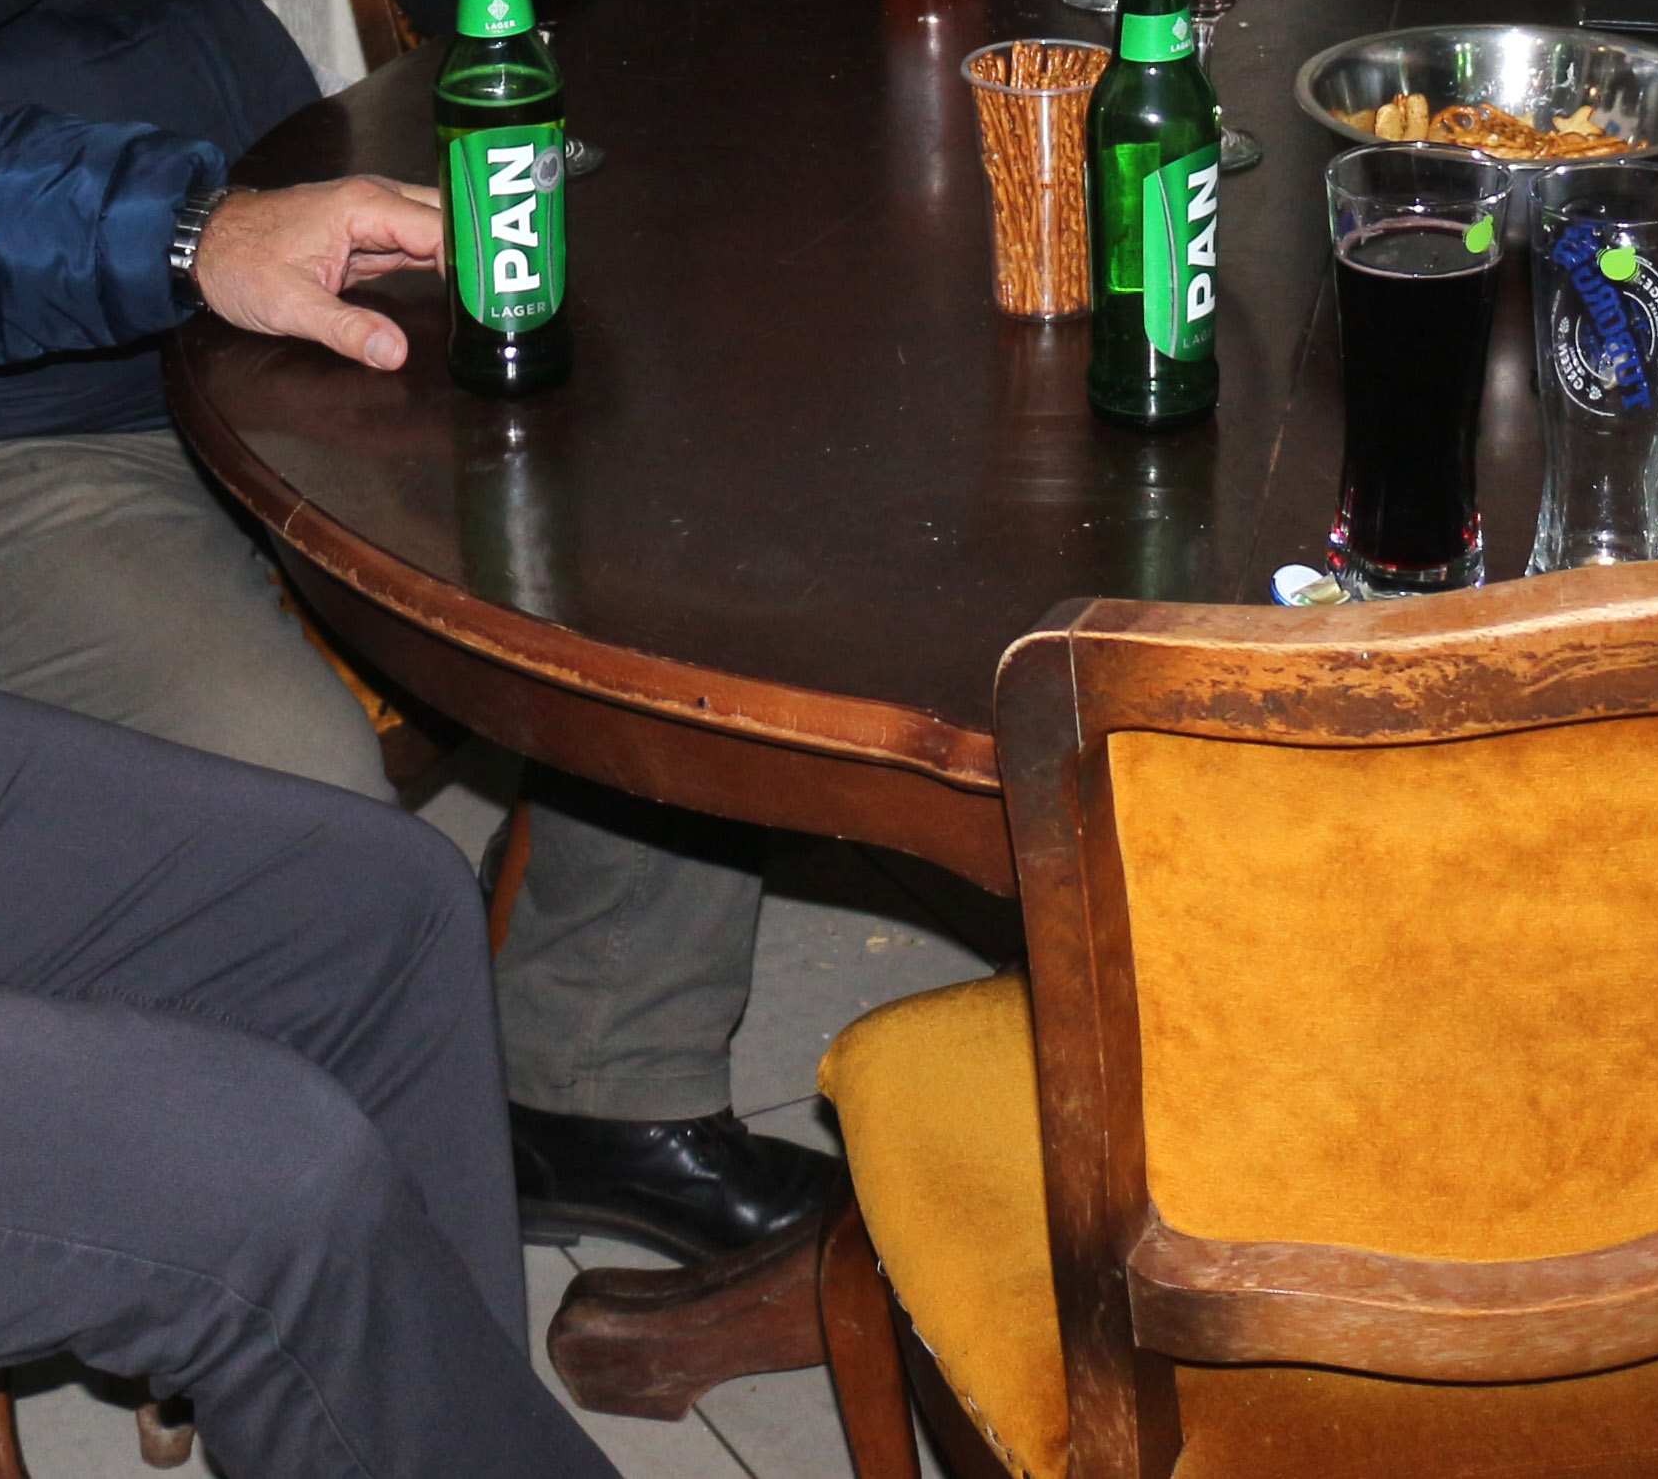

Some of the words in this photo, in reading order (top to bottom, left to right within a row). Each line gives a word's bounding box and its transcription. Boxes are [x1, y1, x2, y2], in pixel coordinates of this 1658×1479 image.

[484, 19, 516, 31] LAGER
[486, 142, 542, 295] PAN
[1186, 161, 1219, 324] PAN
[491, 301, 546, 319] LAGER
